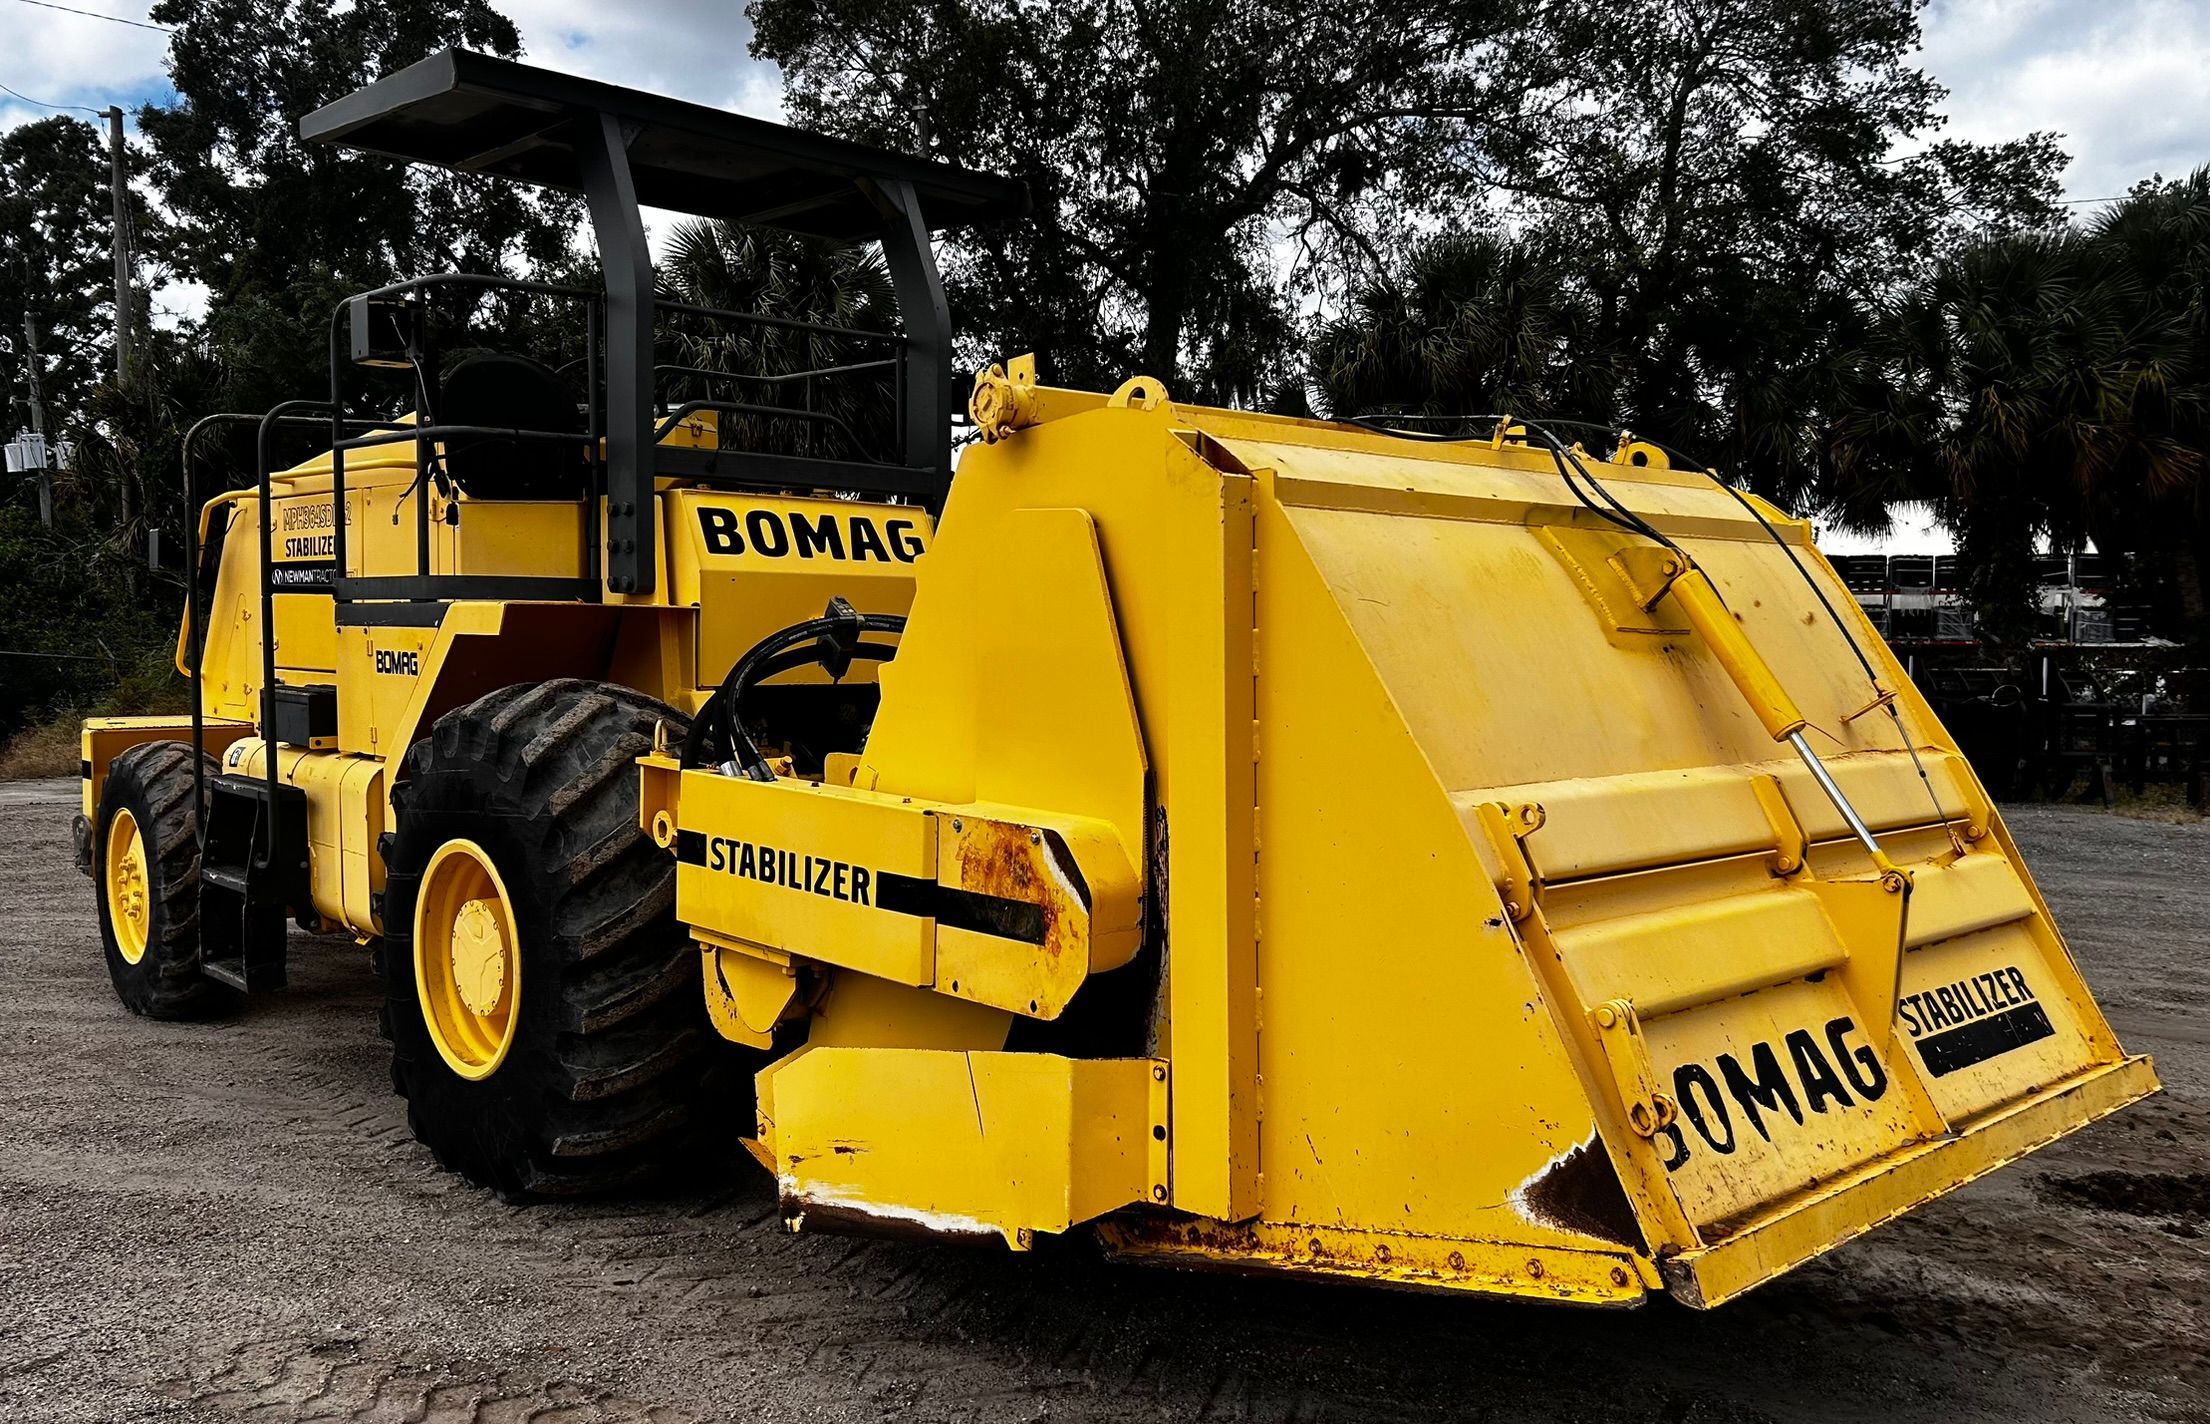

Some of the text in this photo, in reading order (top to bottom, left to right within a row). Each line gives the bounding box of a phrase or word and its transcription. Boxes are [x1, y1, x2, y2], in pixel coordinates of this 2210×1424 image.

[283, 501, 352, 531] MPH364SD2
[286, 534, 336, 557] STABILIZE
[697, 507, 925, 564] BOMAG
[284, 568, 337, 583] NEWMANTRACTO
[376, 650, 418, 676] BOMAG
[710, 837, 870, 906] STABILIZER
[1898, 966, 2035, 1037] STABILIZER
